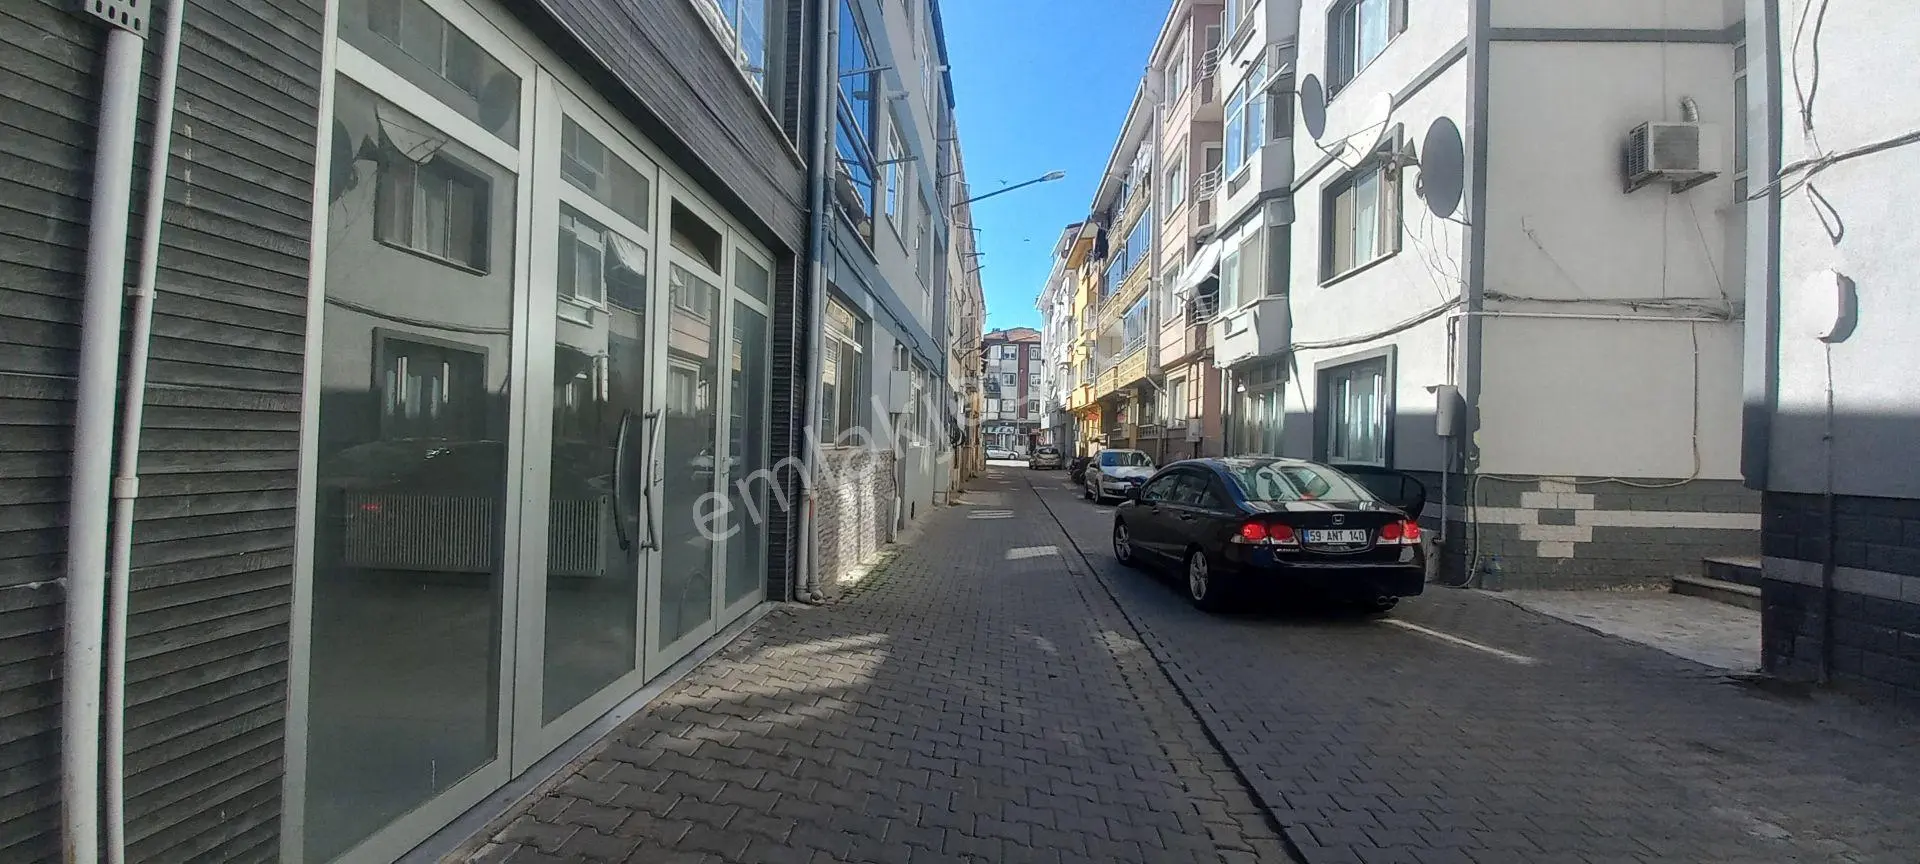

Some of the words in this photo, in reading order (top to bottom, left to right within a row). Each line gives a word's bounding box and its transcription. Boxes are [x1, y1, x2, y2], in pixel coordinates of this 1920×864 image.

[1310, 530, 1322, 541] 59
[1327, 530, 1344, 541] ANT
[1349, 530, 1365, 541] 140
